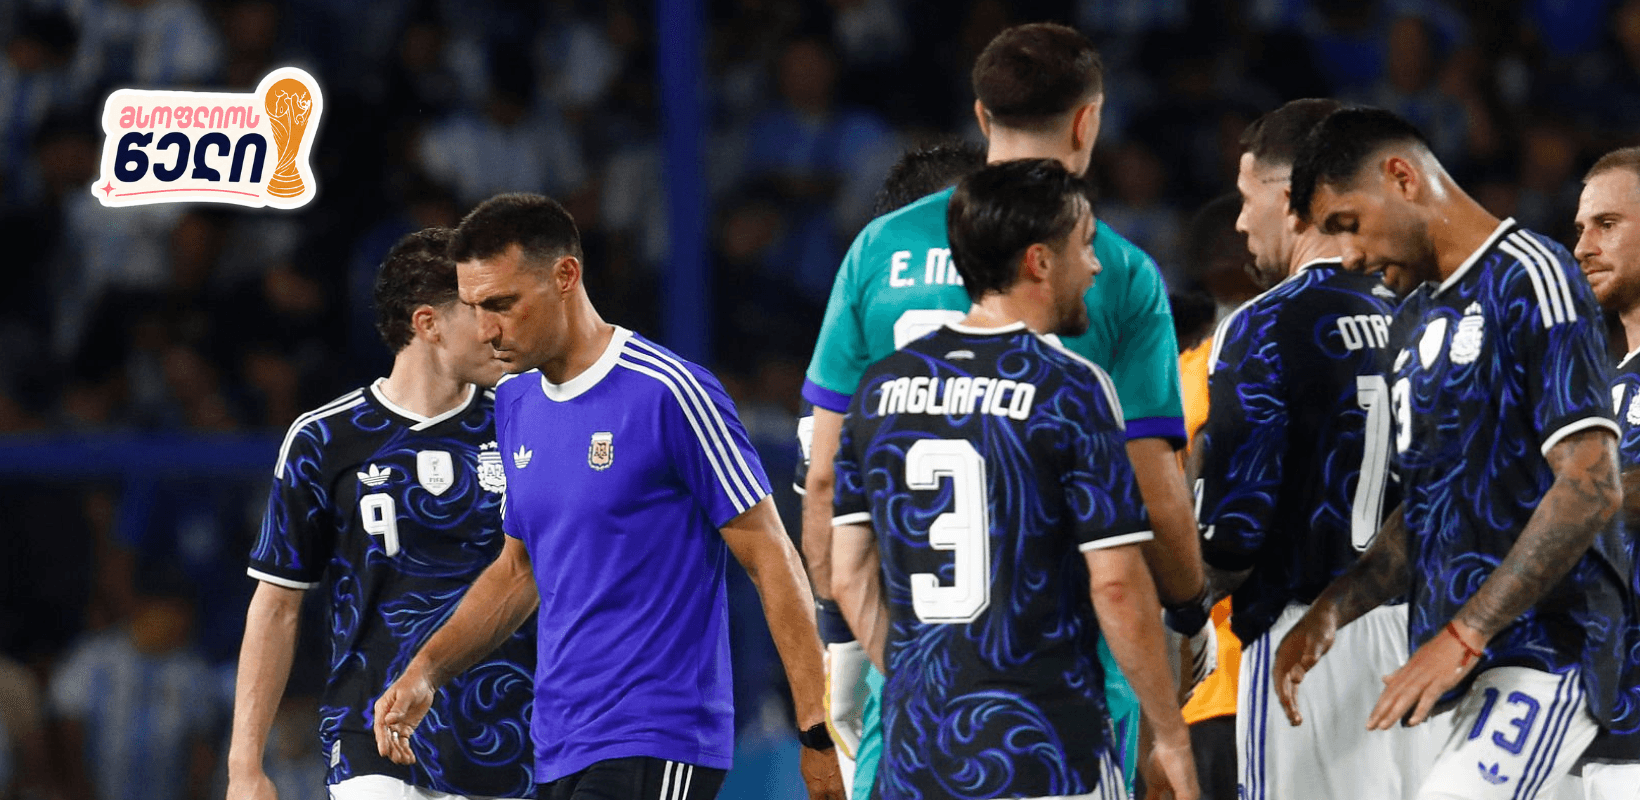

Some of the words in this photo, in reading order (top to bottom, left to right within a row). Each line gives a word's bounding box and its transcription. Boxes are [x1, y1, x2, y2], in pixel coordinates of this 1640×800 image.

[889, 250, 915, 288] E.
[925, 247, 965, 286] M
[1337, 314, 1393, 351] OTA
[877, 376, 1037, 421] TAGLIAFICO
[359, 492, 400, 558] 9
[905, 438, 991, 624] 3
[1467, 686, 1541, 755] 13
